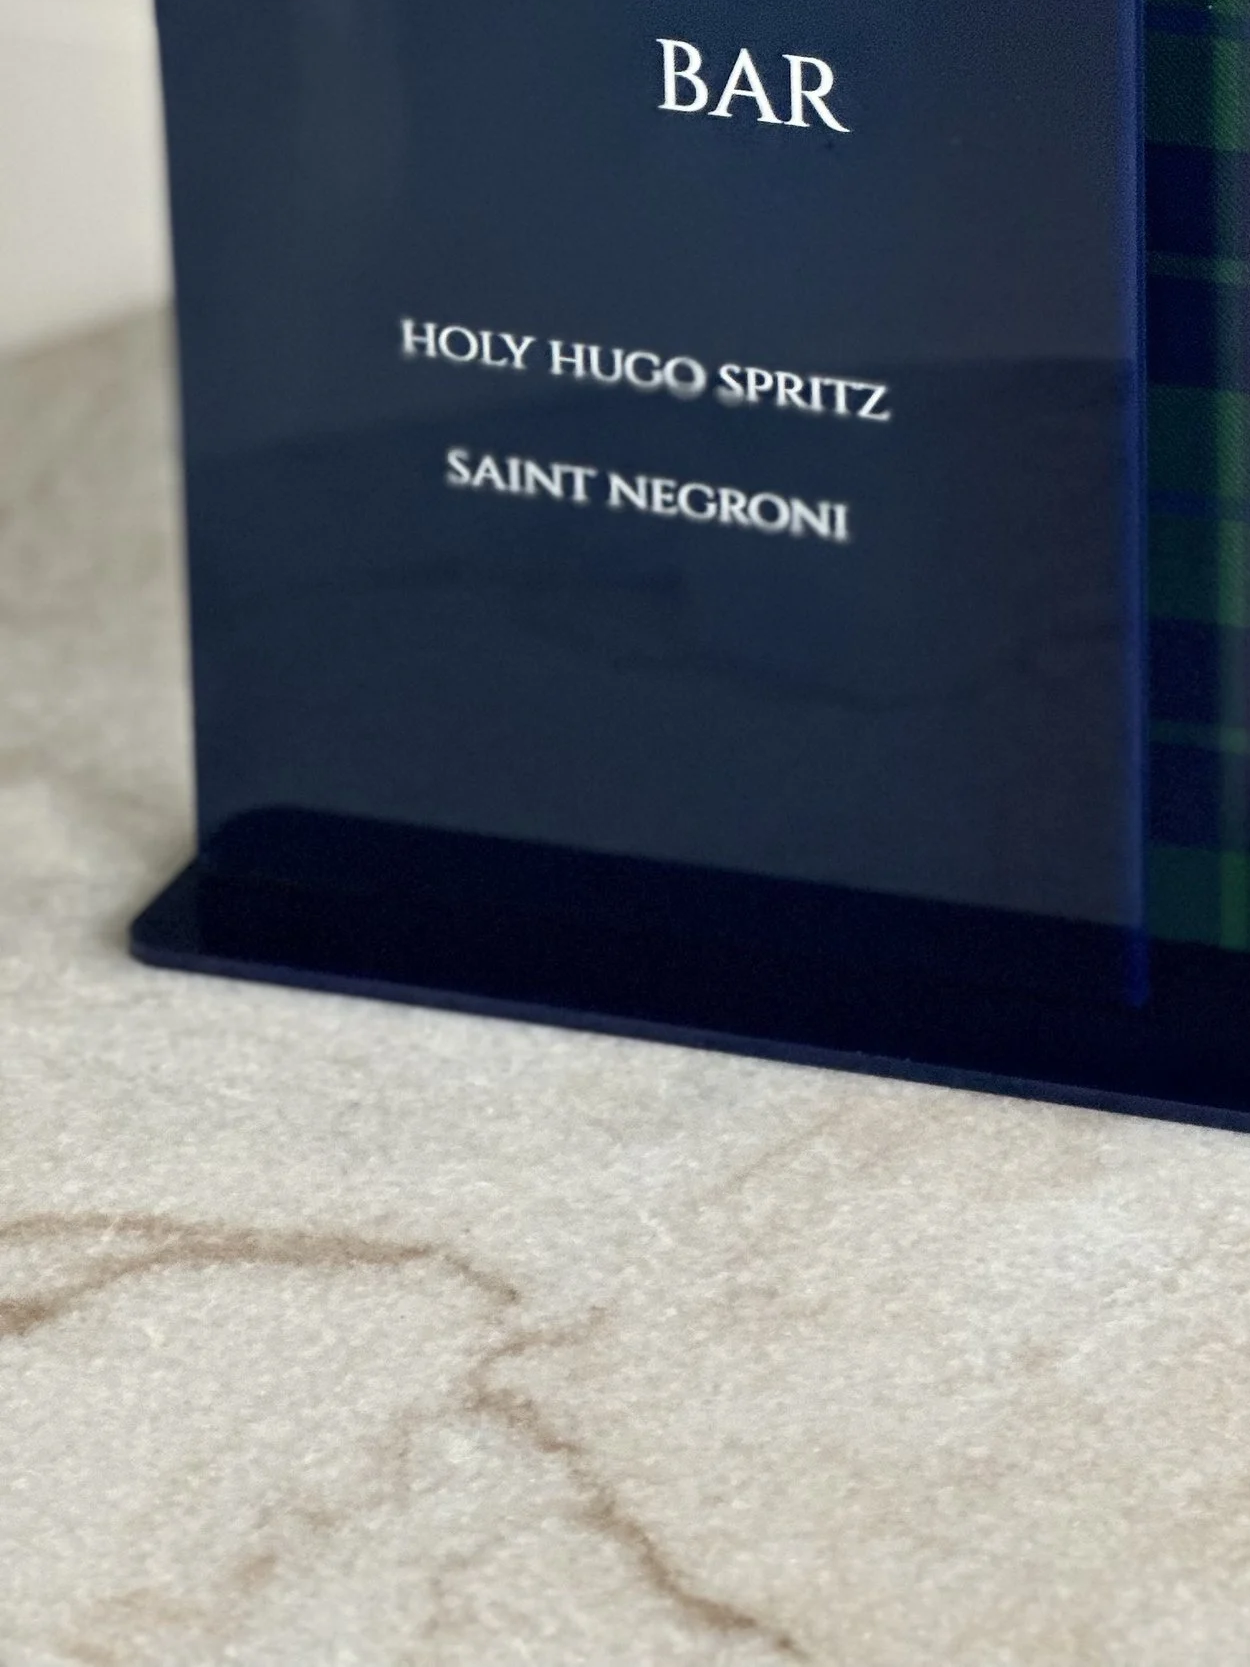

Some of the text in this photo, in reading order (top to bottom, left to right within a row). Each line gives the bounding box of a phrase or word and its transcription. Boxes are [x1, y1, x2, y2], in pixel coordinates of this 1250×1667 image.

[656, 38, 851, 133] BAR
[400, 317, 892, 422] HOLY HUGO SPRITZ
[446, 447, 849, 543] SAINT NEGRONI
